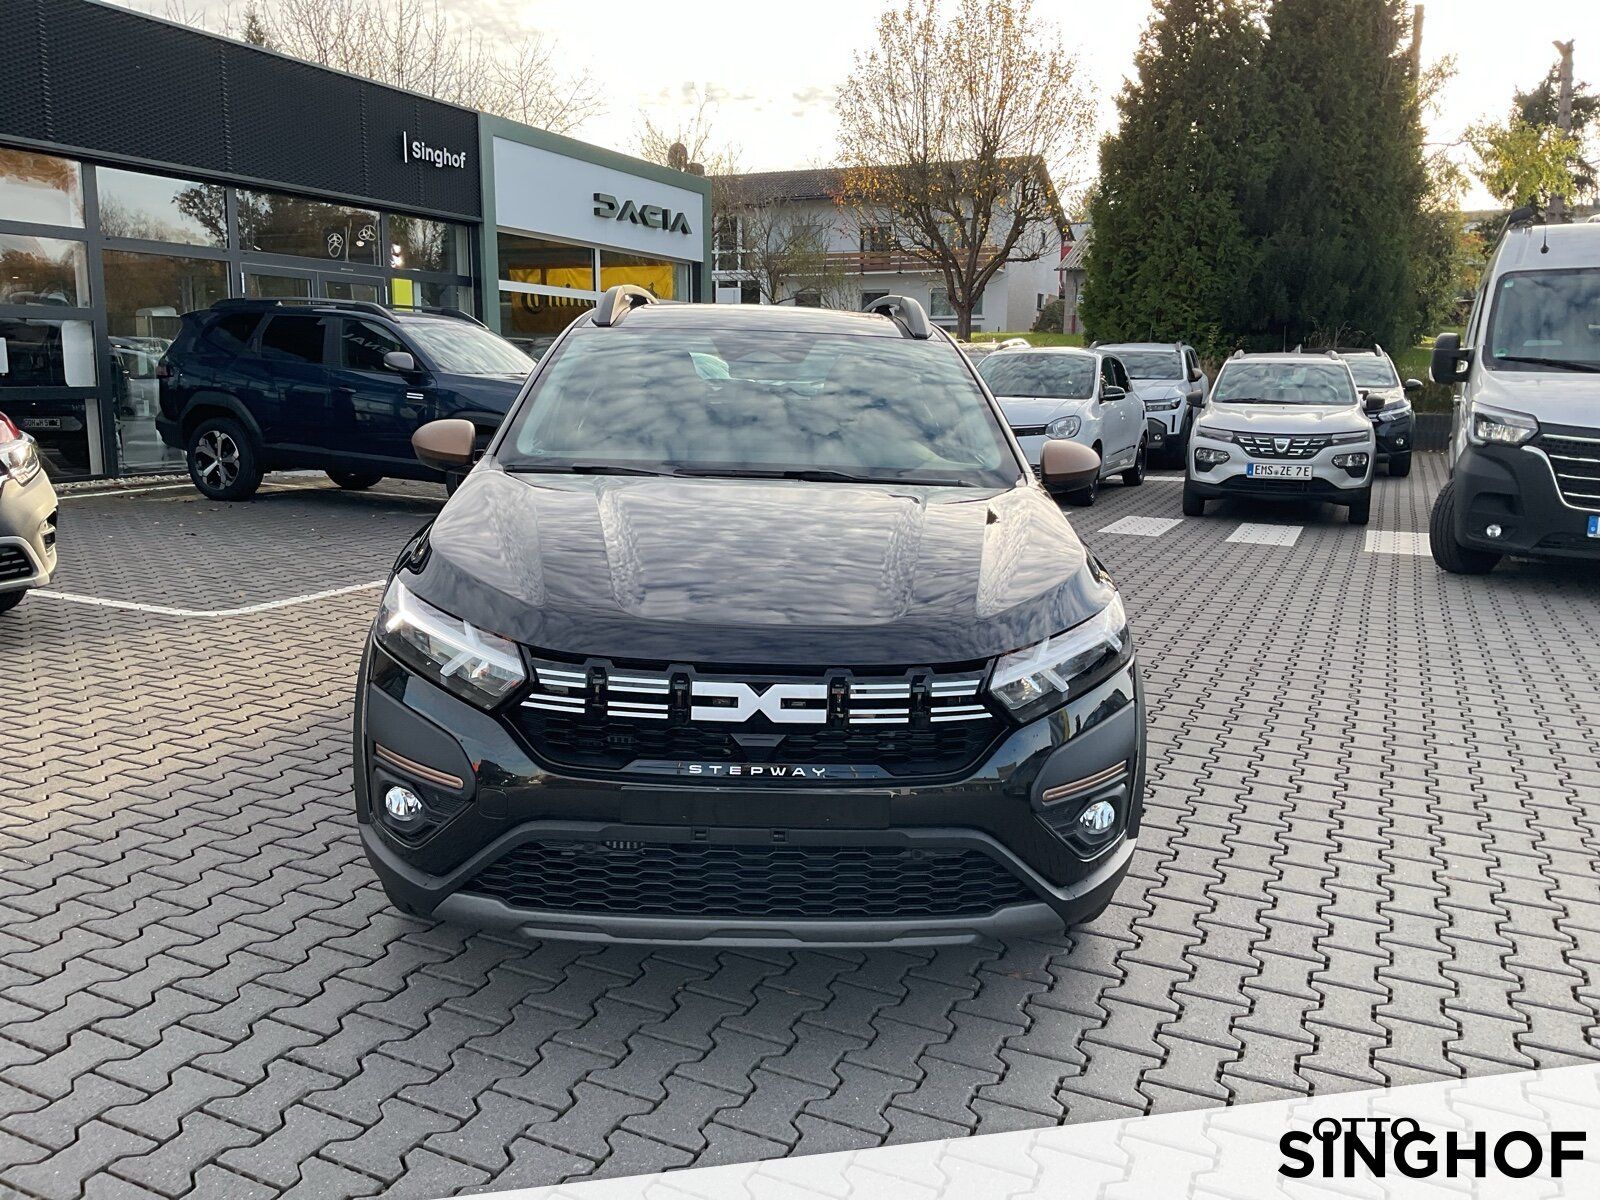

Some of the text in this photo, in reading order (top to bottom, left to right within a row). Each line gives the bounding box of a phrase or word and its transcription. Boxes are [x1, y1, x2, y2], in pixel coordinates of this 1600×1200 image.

[412, 141, 466, 169] Singhof
[593, 192, 693, 235] DACIA
[1254, 465, 1274, 476] EMS
[1279, 465, 1292, 476] ZE
[689, 764, 826, 777] STEPWAY
